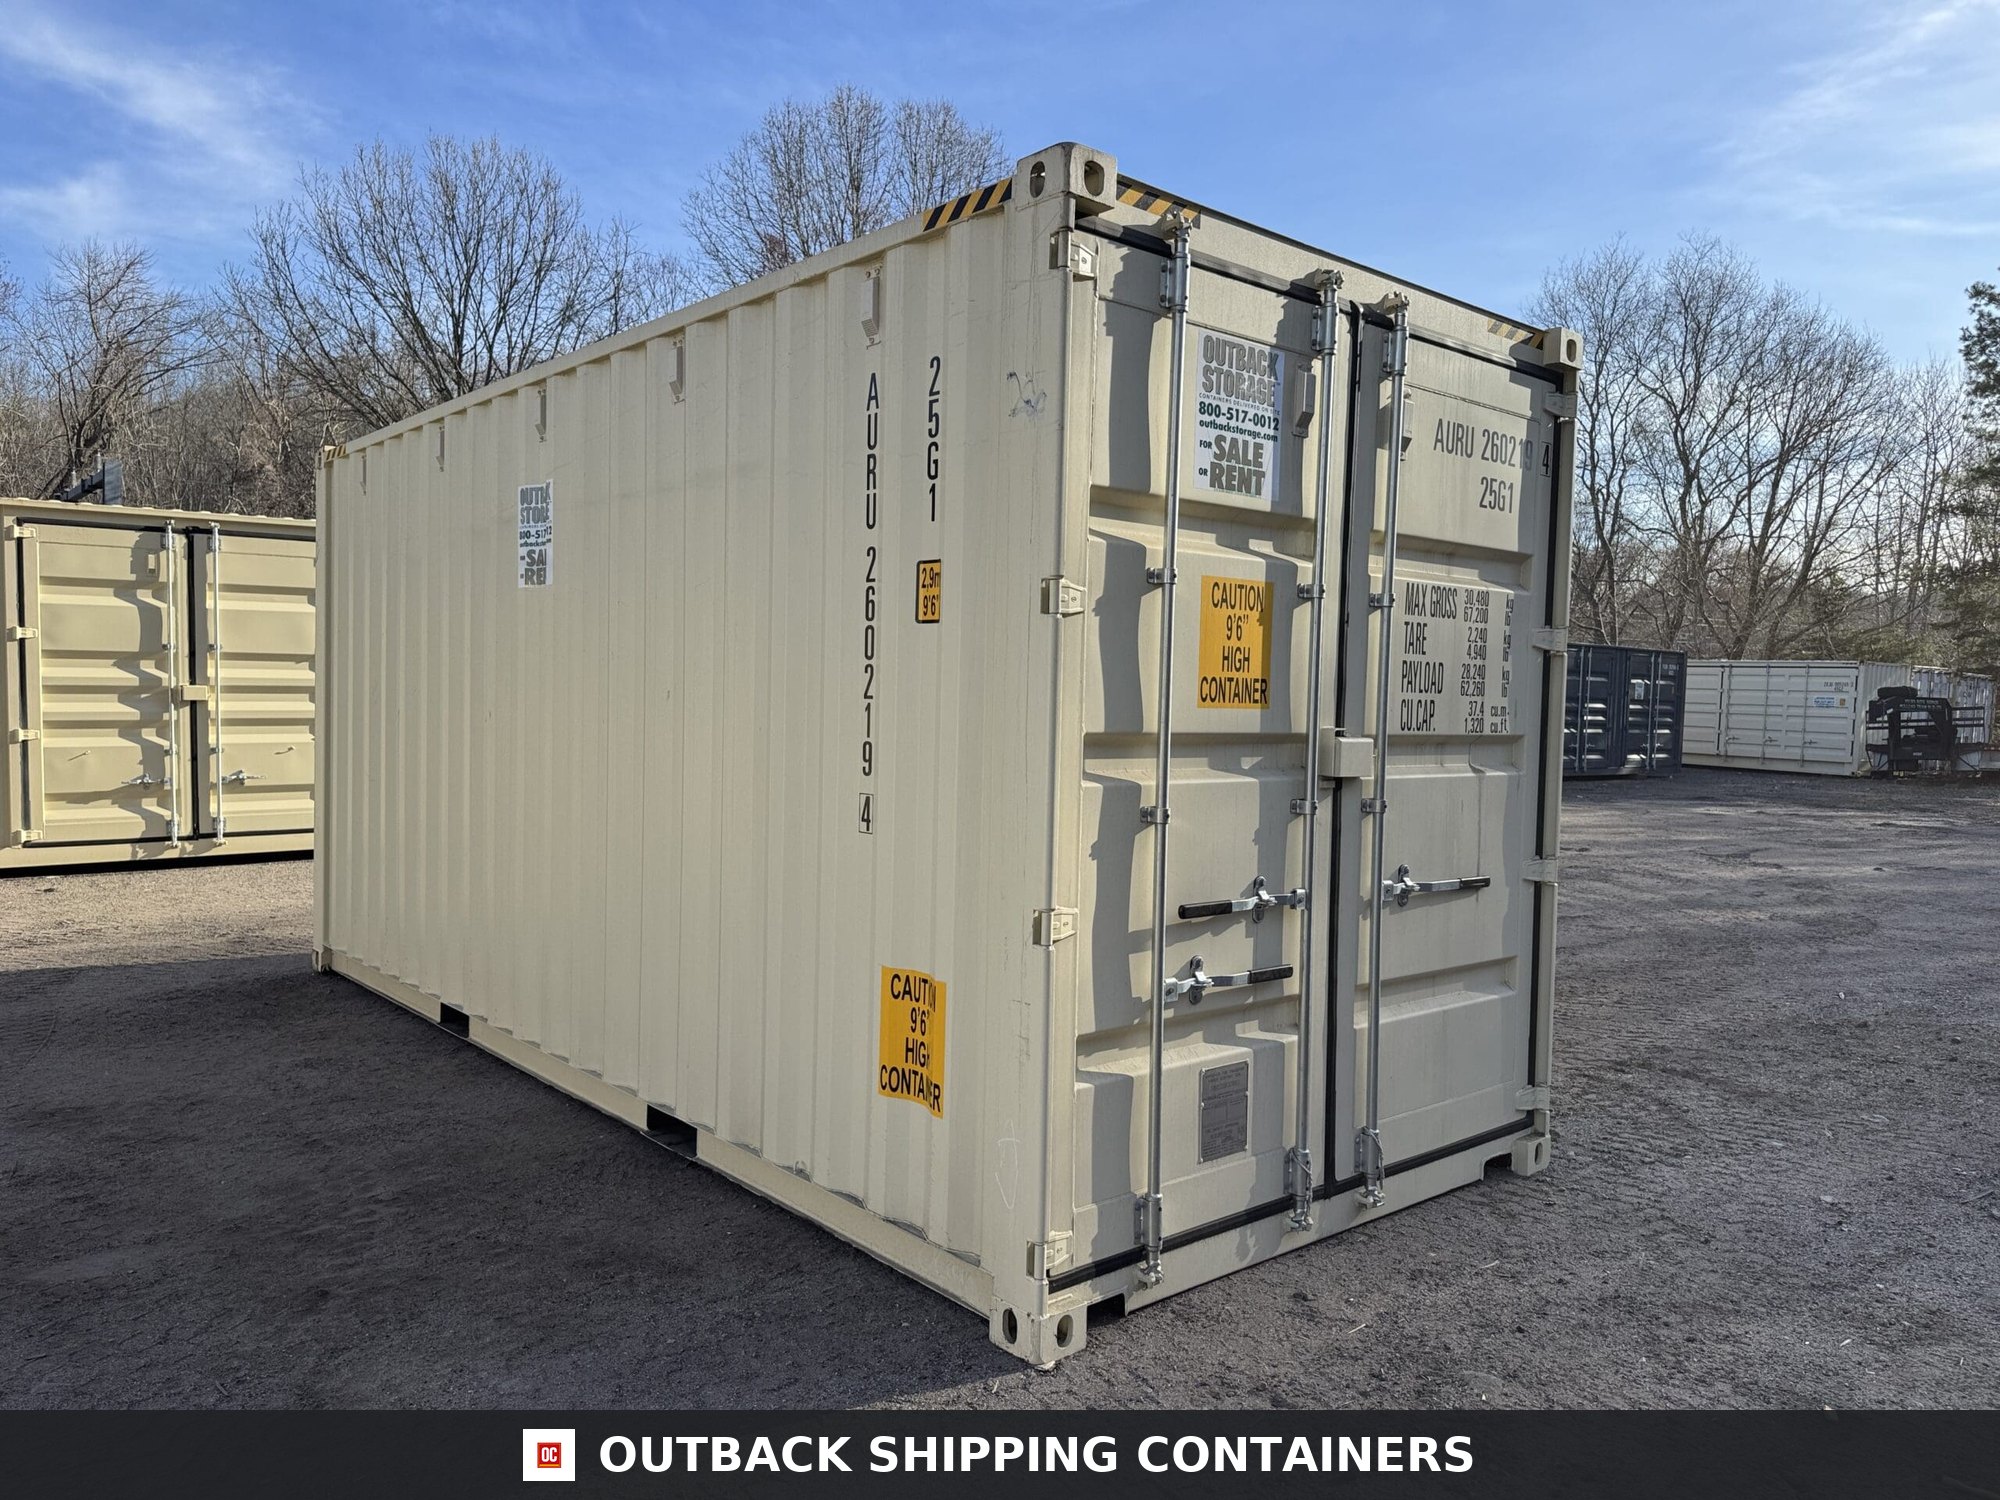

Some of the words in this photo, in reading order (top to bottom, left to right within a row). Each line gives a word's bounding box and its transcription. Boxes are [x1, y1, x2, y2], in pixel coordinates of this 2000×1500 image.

[1202, 334, 1279, 381] OUTBACK
[1201, 364, 1276, 408] STORAGE
[1198, 401, 1280, 431] 800-517-0012
[1199, 419, 1279, 443] outbackstorage.com
[866, 372, 879, 530] AURU
[927, 356, 941, 522] 25G1
[1199, 439, 1212, 450] FOR
[1213, 434, 1264, 469] SALE
[1433, 418, 1475, 459] AURU
[1481, 428, 1534, 471] 260219
[1542, 444, 1550, 475] 4
[1198, 467, 1208, 477] OR
[1209, 461, 1266, 496] RENT
[1479, 476, 1514, 514] 25G1
[1211, 581, 1264, 613] CAUTION
[1404, 582, 1428, 617] MAX
[1429, 585, 1458, 620] GROSS
[1464, 589, 1490, 608] 30,480
[1506, 594, 1514, 614] kg
[1463, 606, 1489, 624] 67,200
[1404, 621, 1428, 656] TARE
[1467, 627, 1488, 644] 2,240
[1466, 644, 1487, 661] 4,940
[862, 546, 877, 777] 260219
[1221, 645, 1251, 673] HIGH
[1200, 676, 1268, 705] CONTAINER
[1401, 660, 1444, 695] PAYLOAD
[1461, 663, 1486, 681] 28,240
[1460, 681, 1486, 697] 62,260
[1400, 699, 1436, 732] CU.CAP.
[1468, 701, 1485, 717] 37.4
[1464, 718, 1485, 735] 1,320
[861, 795, 871, 832] 4
[880, 1064, 941, 1113] CONTAER
